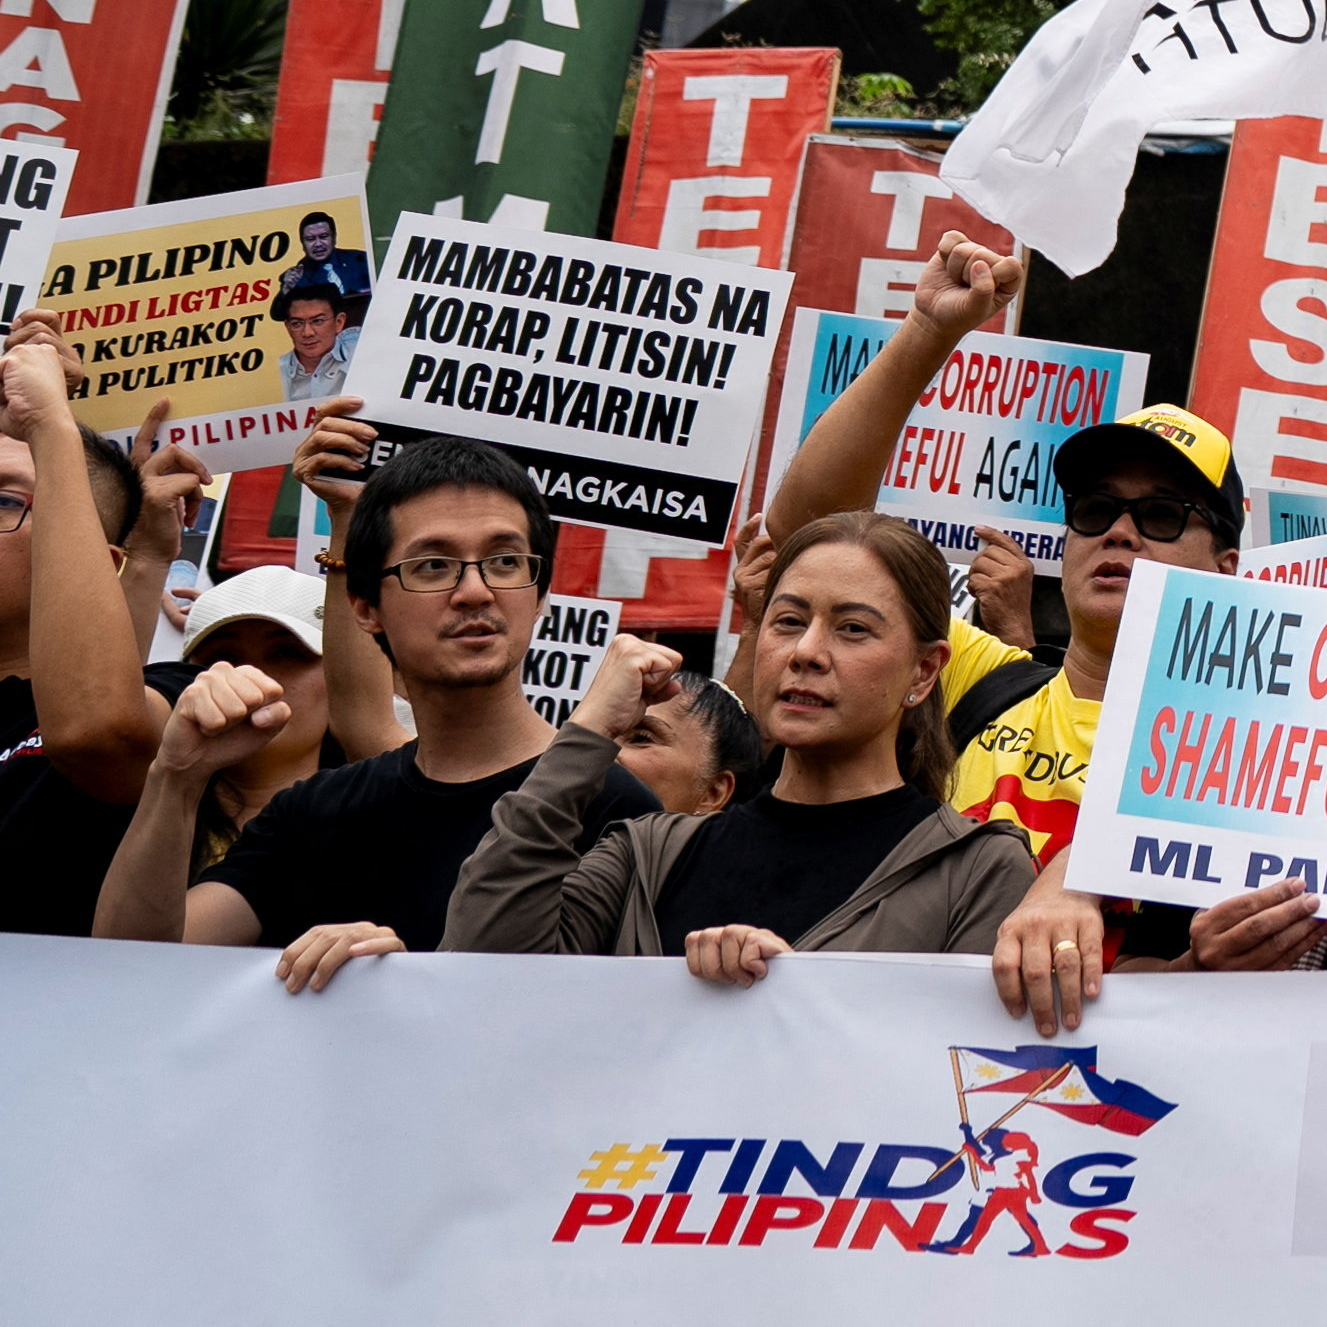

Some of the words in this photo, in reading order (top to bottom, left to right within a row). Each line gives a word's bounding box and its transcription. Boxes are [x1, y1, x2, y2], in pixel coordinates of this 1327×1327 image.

[84, 230, 291, 292] PILIPINO
[398, 235, 703, 326] MAMBABATAS
[706, 286, 772, 338] NA
[146, 278, 272, 319] LIGTAS
[91, 313, 264, 364] KURAKOT
[399, 293, 552, 364] KORAP,
[555, 315, 738, 391] LITISIN!
[96, 348, 265, 397] PULITIKO
[399, 353, 700, 448] PAGBAYARIN!
[1154, 414, 1188, 428] AUGUST
[1167, 597, 1302, 696] MAKE
[1129, 836, 1222, 885] ML
